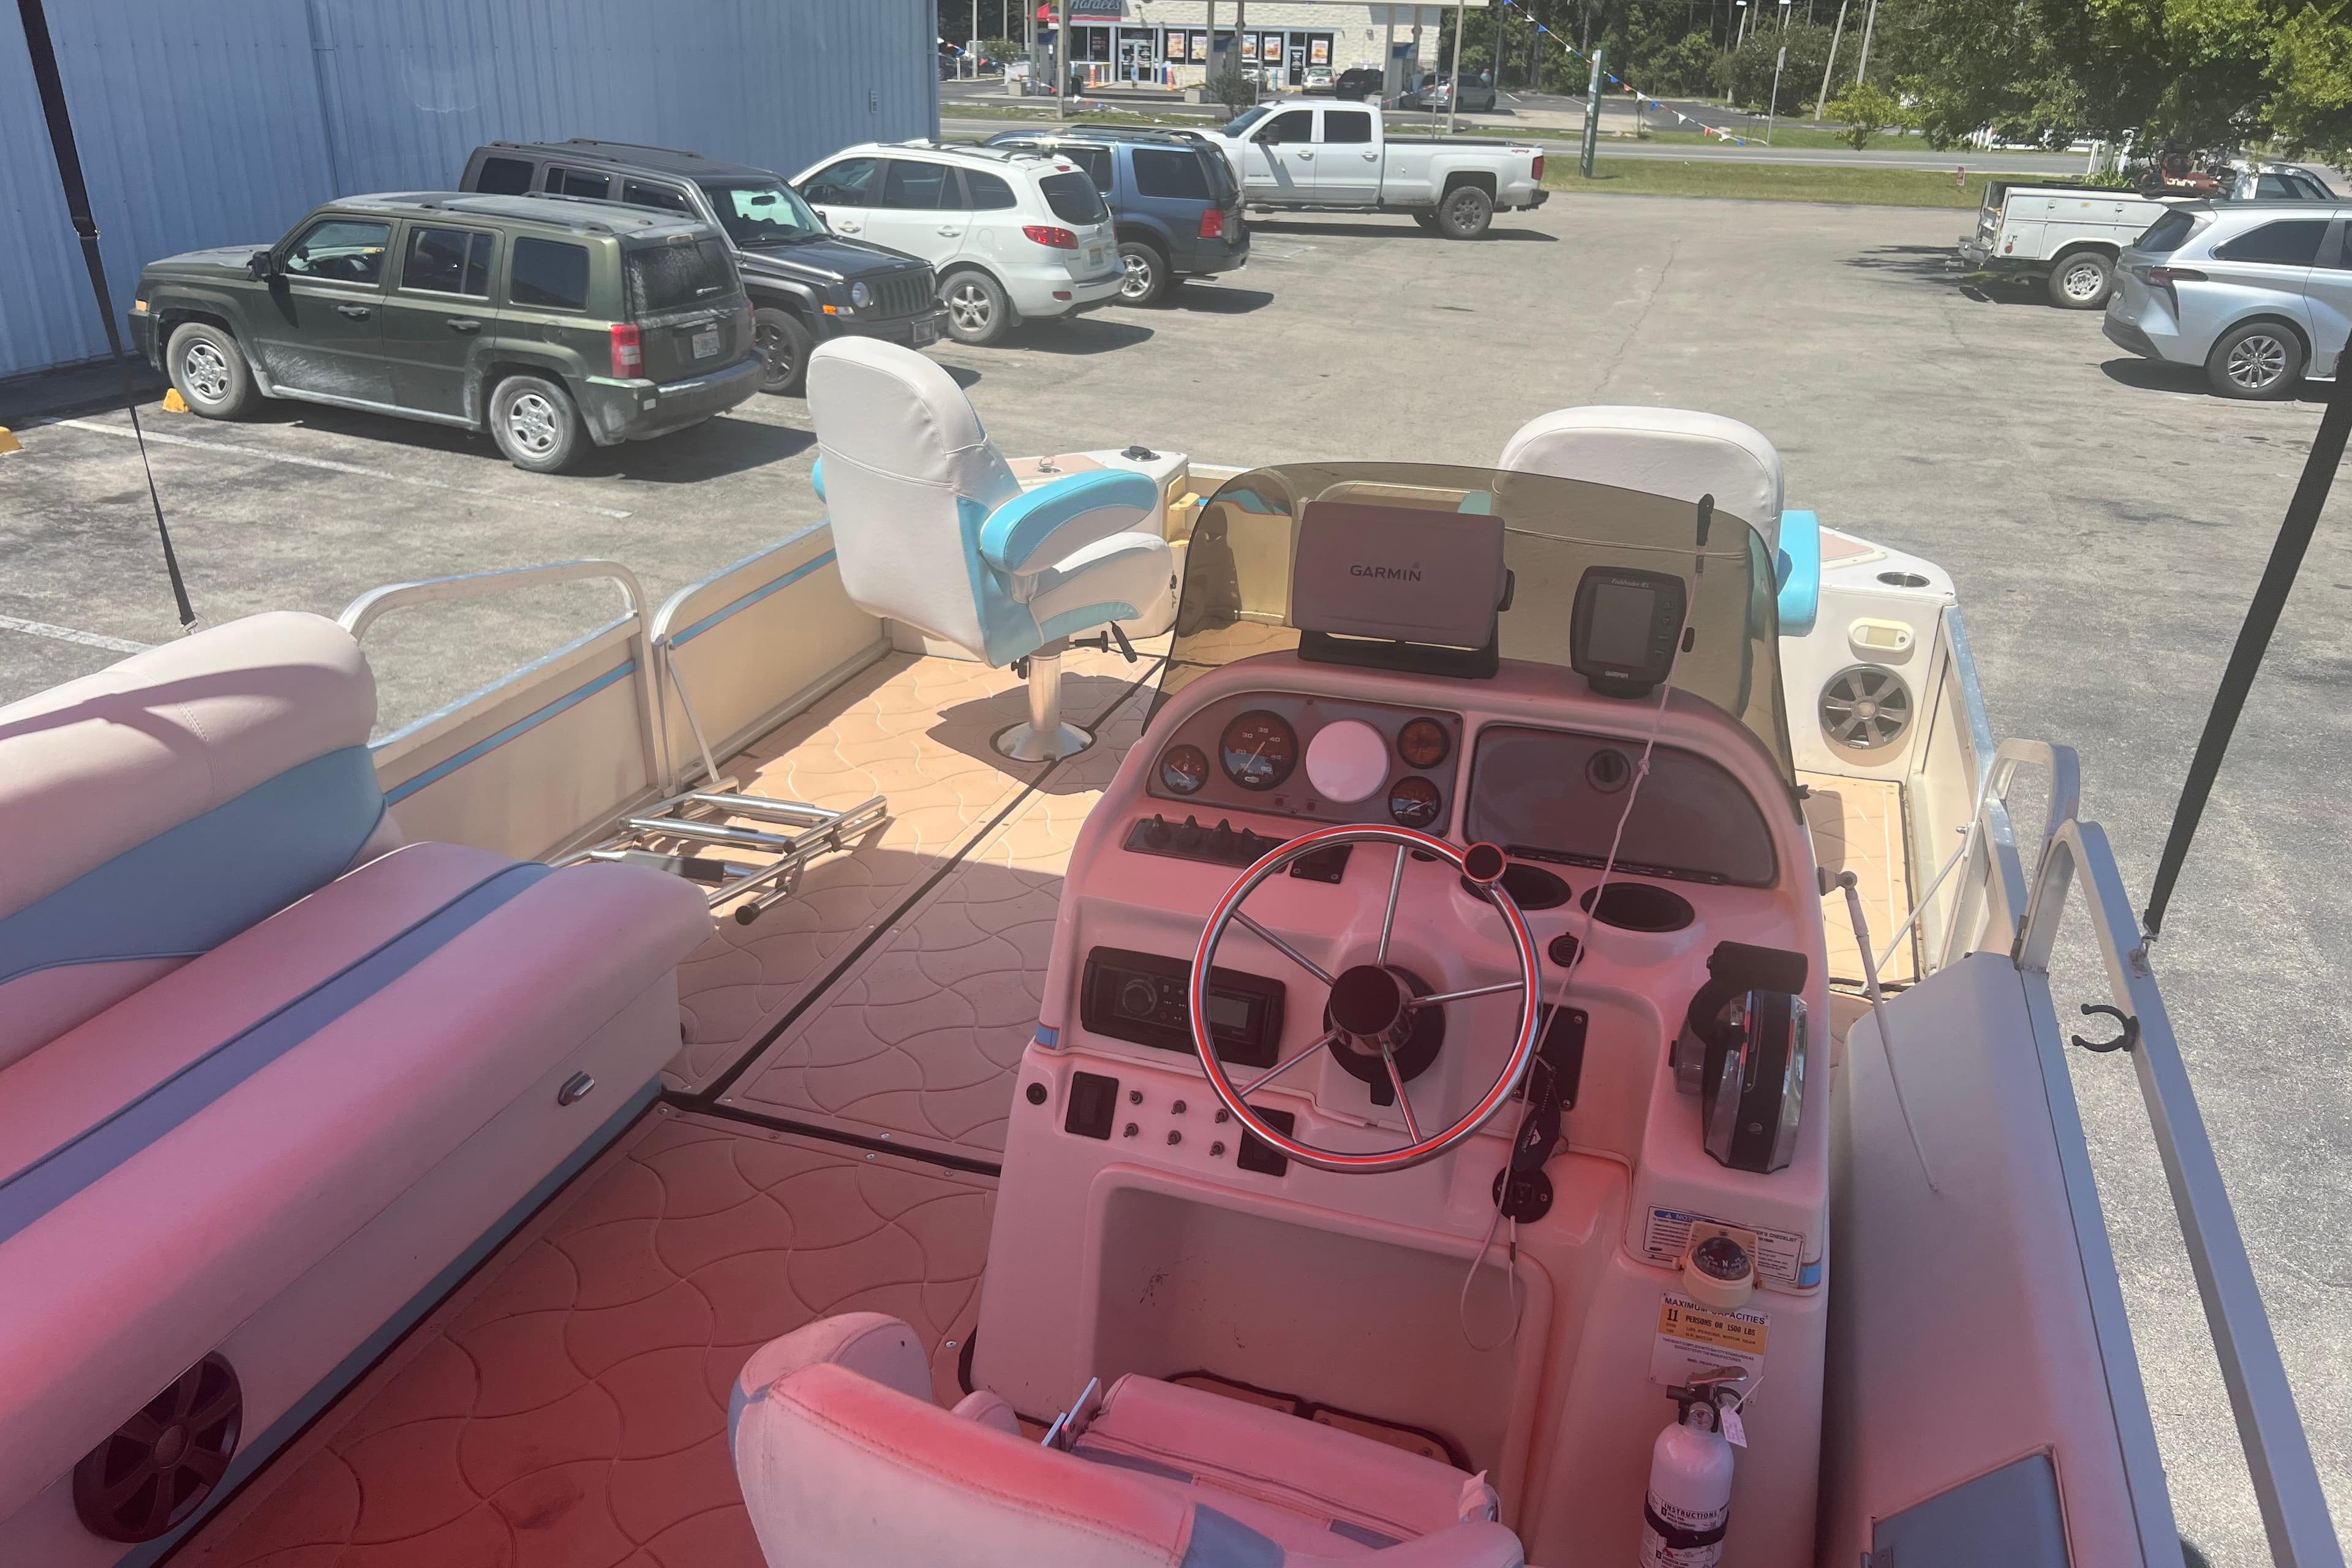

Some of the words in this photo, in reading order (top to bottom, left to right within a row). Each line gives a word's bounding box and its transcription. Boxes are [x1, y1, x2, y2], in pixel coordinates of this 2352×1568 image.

[1349, 564, 1422, 582] GARMIN
[1769, 1231, 1798, 1243] CHECKLIST
[1667, 1308, 1678, 1322] 11
[1686, 1315, 1713, 1327] PERSONS
[1664, 1502, 1717, 1519] INSTRUCTIONS
